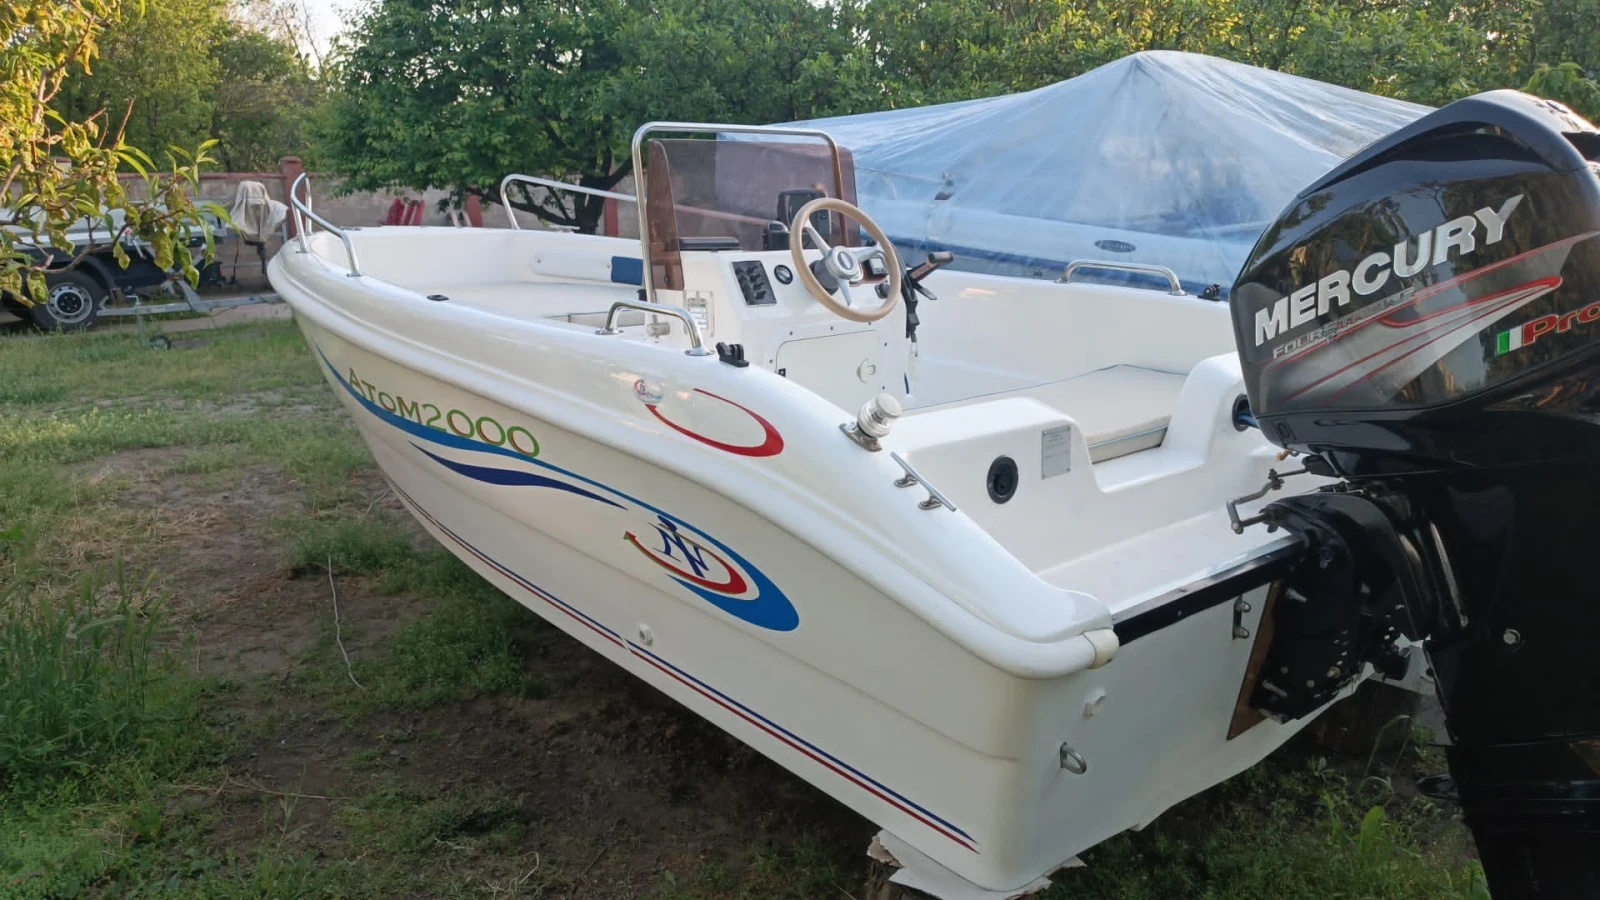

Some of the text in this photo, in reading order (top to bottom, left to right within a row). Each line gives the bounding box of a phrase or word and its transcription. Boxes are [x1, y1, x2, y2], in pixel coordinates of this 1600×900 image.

[1254, 193, 1524, 347] MERCURY
[1272, 286, 1415, 360] FOURSTRKE
[1522, 301, 1600, 347] Pro
